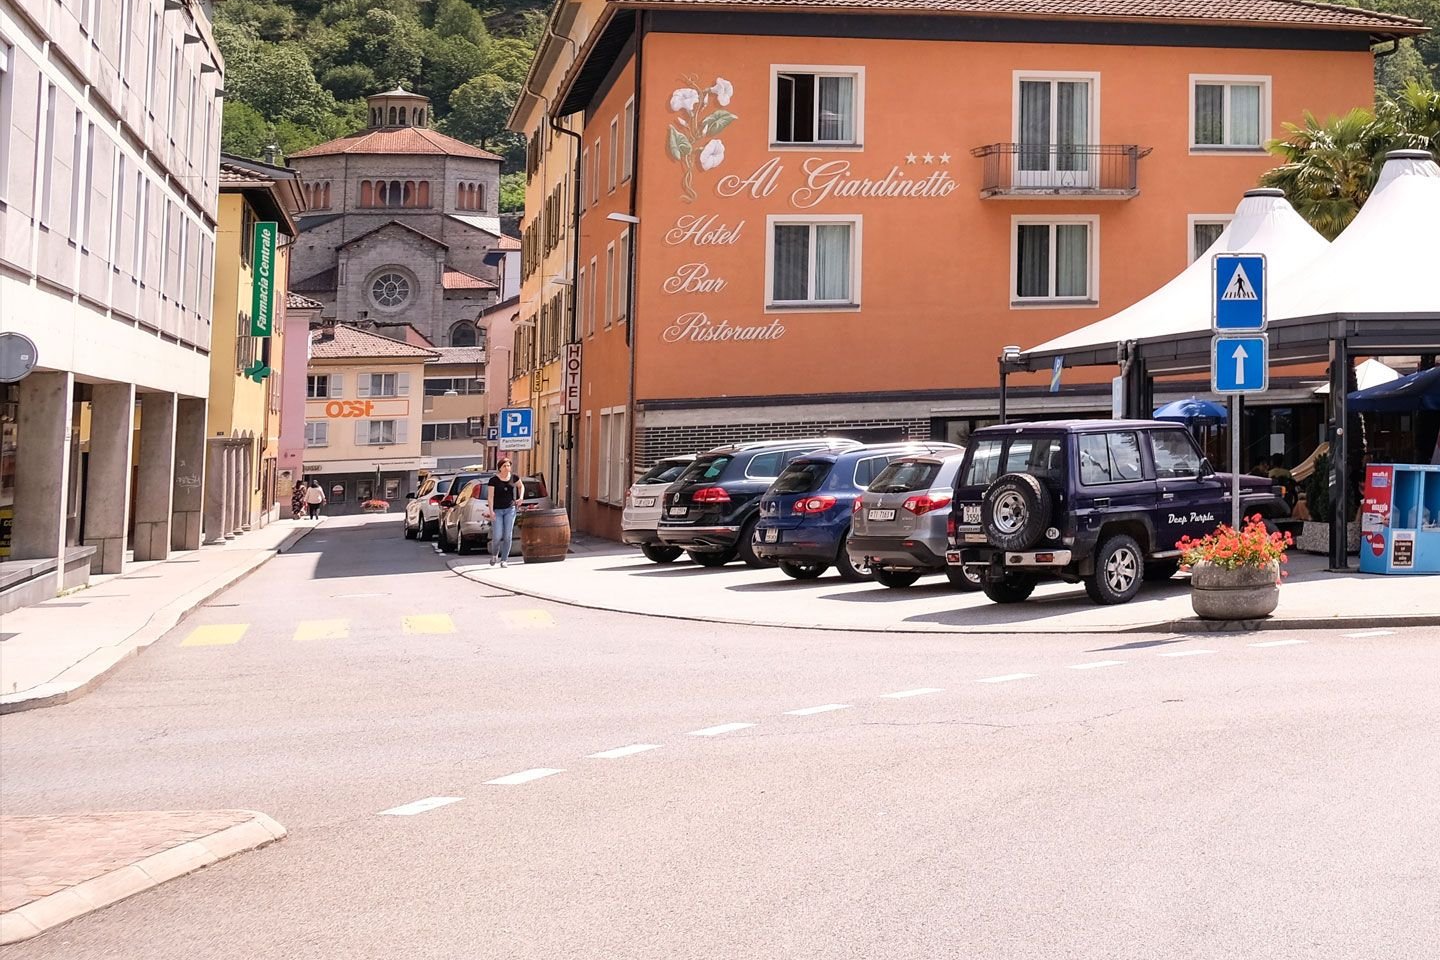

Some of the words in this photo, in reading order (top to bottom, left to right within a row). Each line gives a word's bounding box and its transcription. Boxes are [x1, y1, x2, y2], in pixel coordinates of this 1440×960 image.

[717, 157, 784, 199] Al
[791, 157, 960, 209] Giardinetto
[664, 214, 746, 246] Hotel
[259, 228, 271, 277] Centrale
[663, 262, 729, 294] Bar
[257, 277, 269, 330] Farmacia
[662, 311, 787, 343] Ristorante
[568, 346, 580, 412] HOTEL
[490, 429, 498, 438] P
[507, 412, 522, 434] P
[1048, 529, 1057, 537] CH
[1168, 514, 1187, 525] Deep
[1190, 512, 1214, 523] Purple
